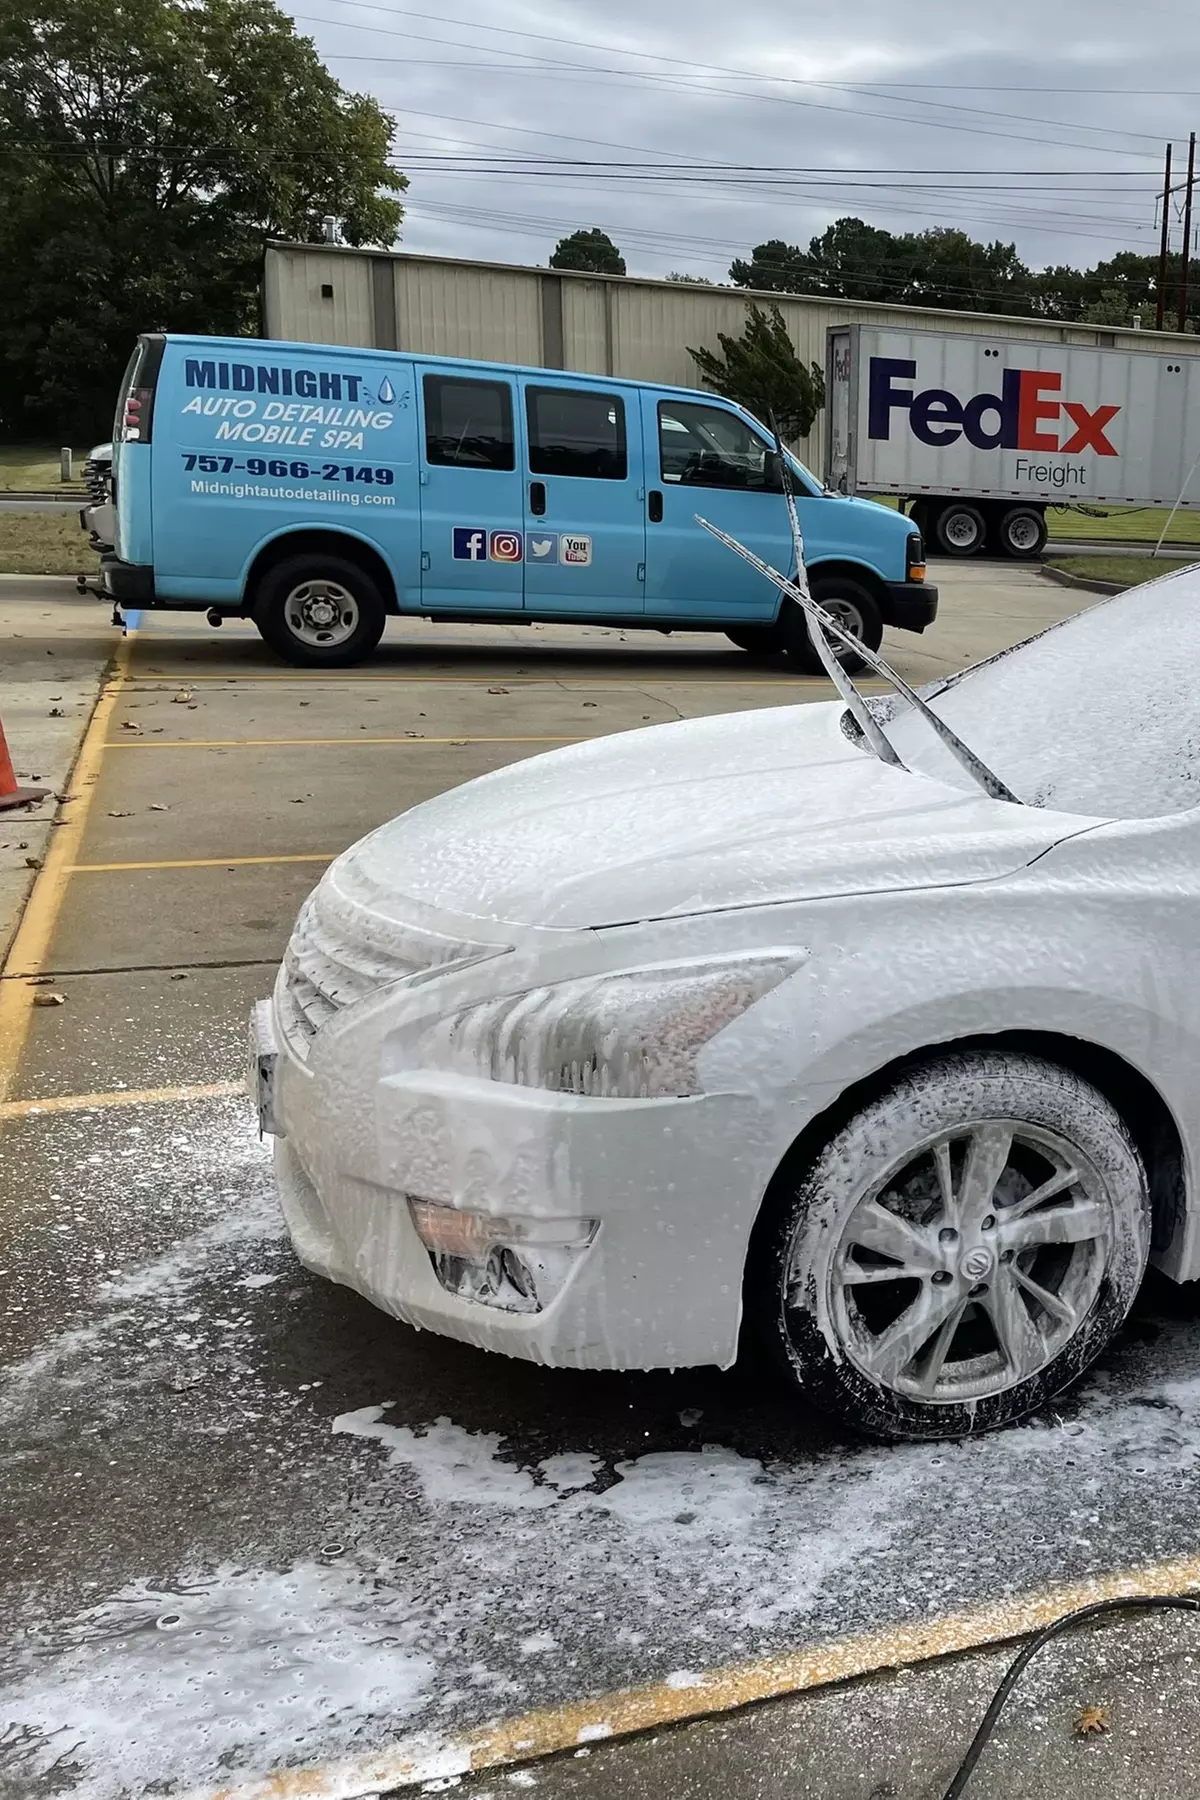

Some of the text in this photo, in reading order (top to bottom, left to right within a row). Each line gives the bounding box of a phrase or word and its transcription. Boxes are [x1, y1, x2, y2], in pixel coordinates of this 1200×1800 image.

[184, 359, 363, 402] MIDNIGHT
[181, 396, 394, 430] AUTO DETAILING
[868, 356, 1122, 457] FedEx
[215, 421, 364, 450] MOBILE SPA
[181, 454, 394, 485] 757-966-2149
[1015, 459, 1086, 487] Freight
[191, 480, 396, 506] Midnightautodetailing.com
[566, 539, 586, 550] You
